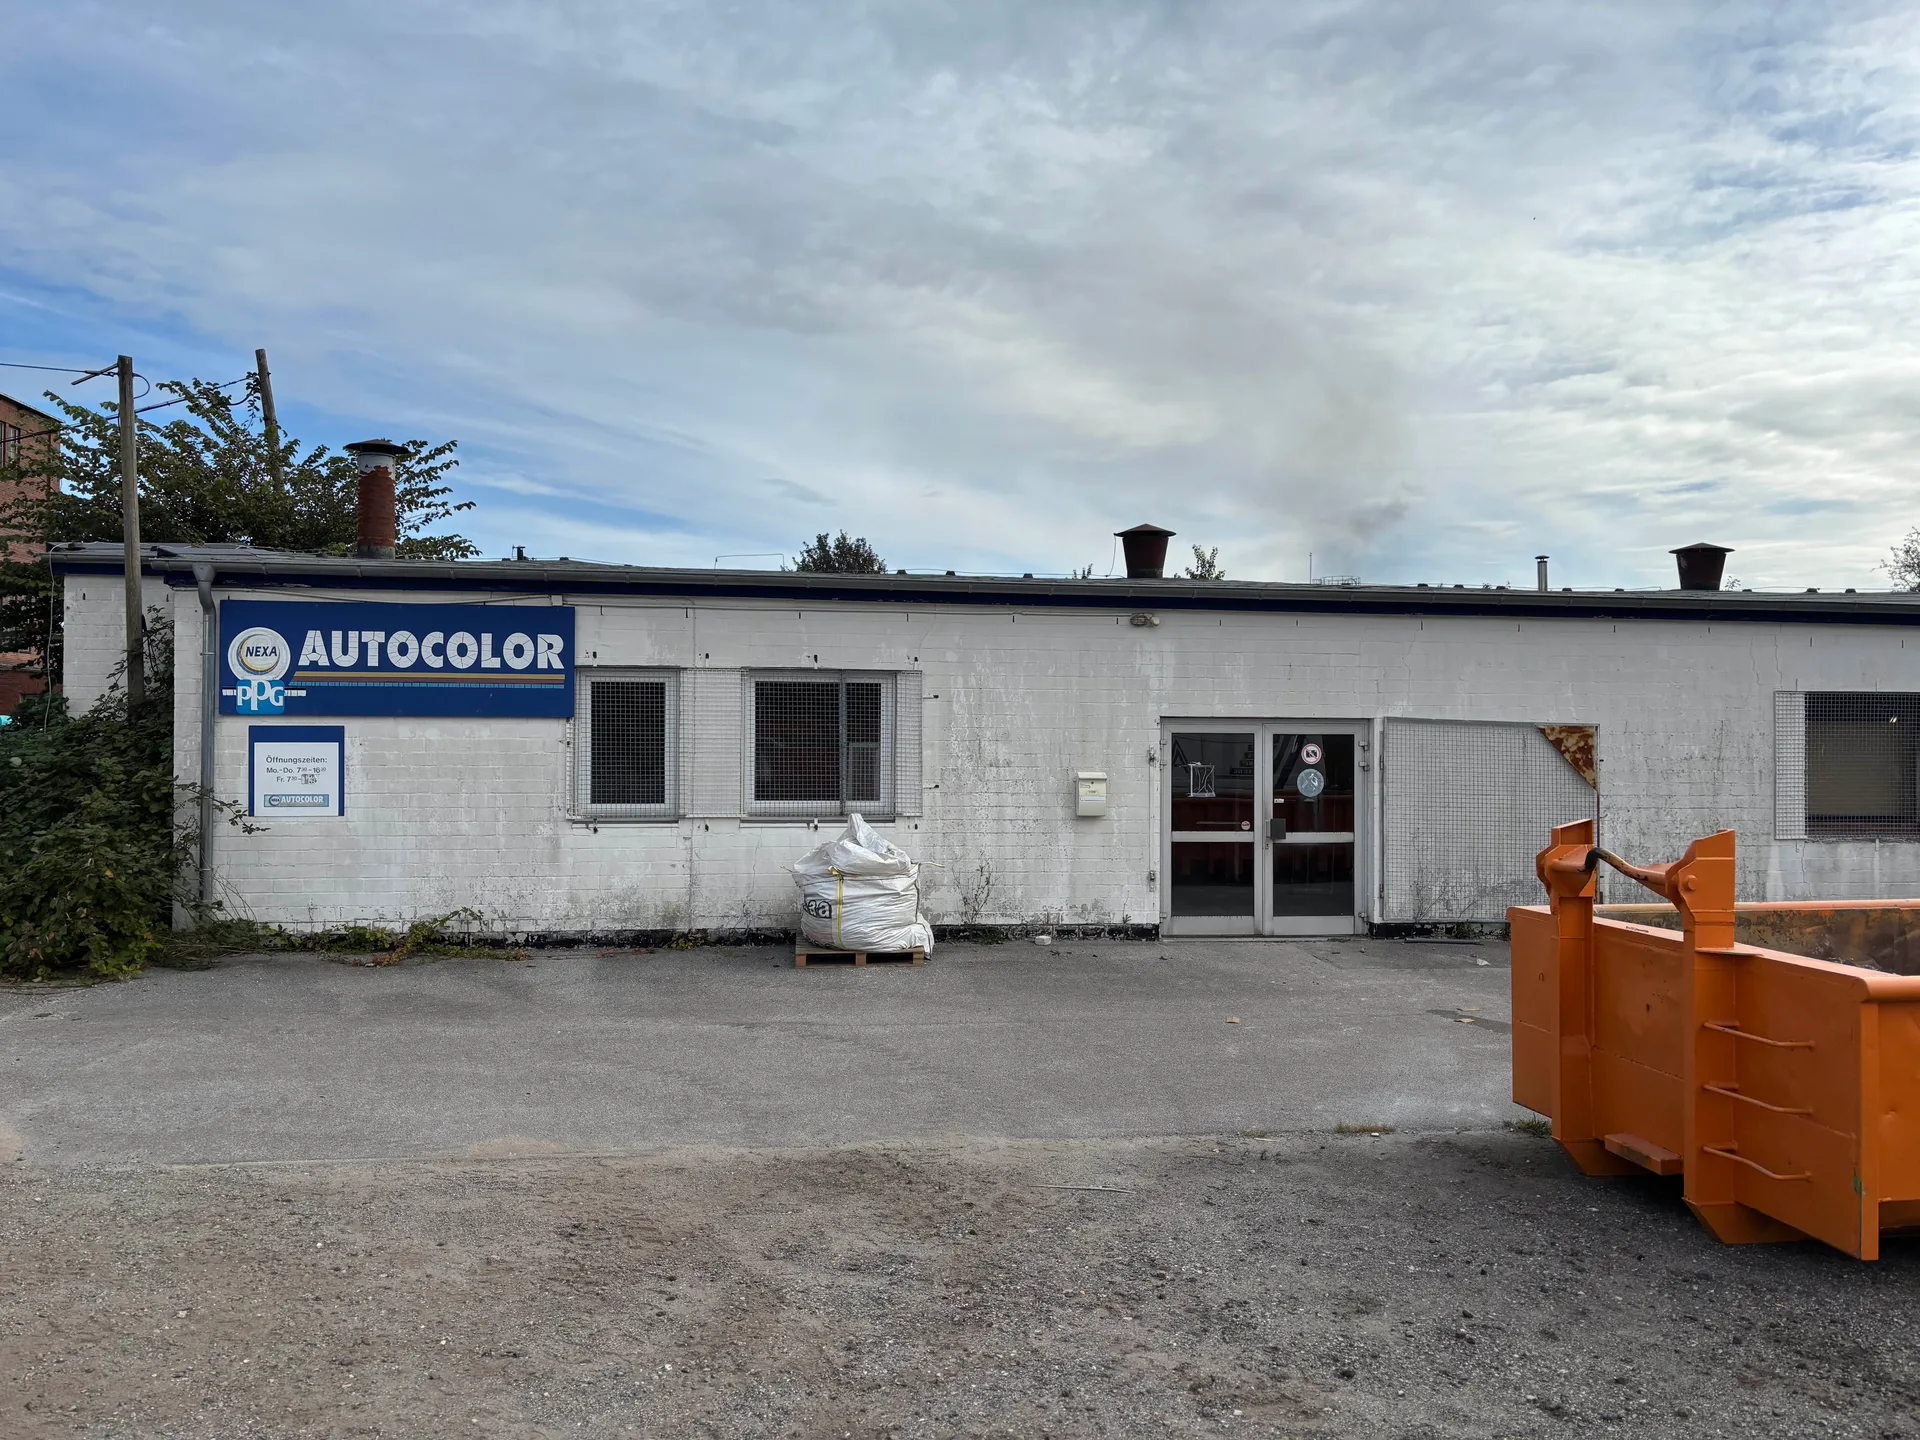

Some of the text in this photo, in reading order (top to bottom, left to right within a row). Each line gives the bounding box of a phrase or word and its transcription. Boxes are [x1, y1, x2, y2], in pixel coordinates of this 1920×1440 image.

[245, 630, 565, 670] NEXA AUTOCOLOR
[237, 680, 284, 711] PPG
[265, 754, 328, 764] Öffnungszeiten:
[280, 795, 324, 803] AUTOCOLOR
